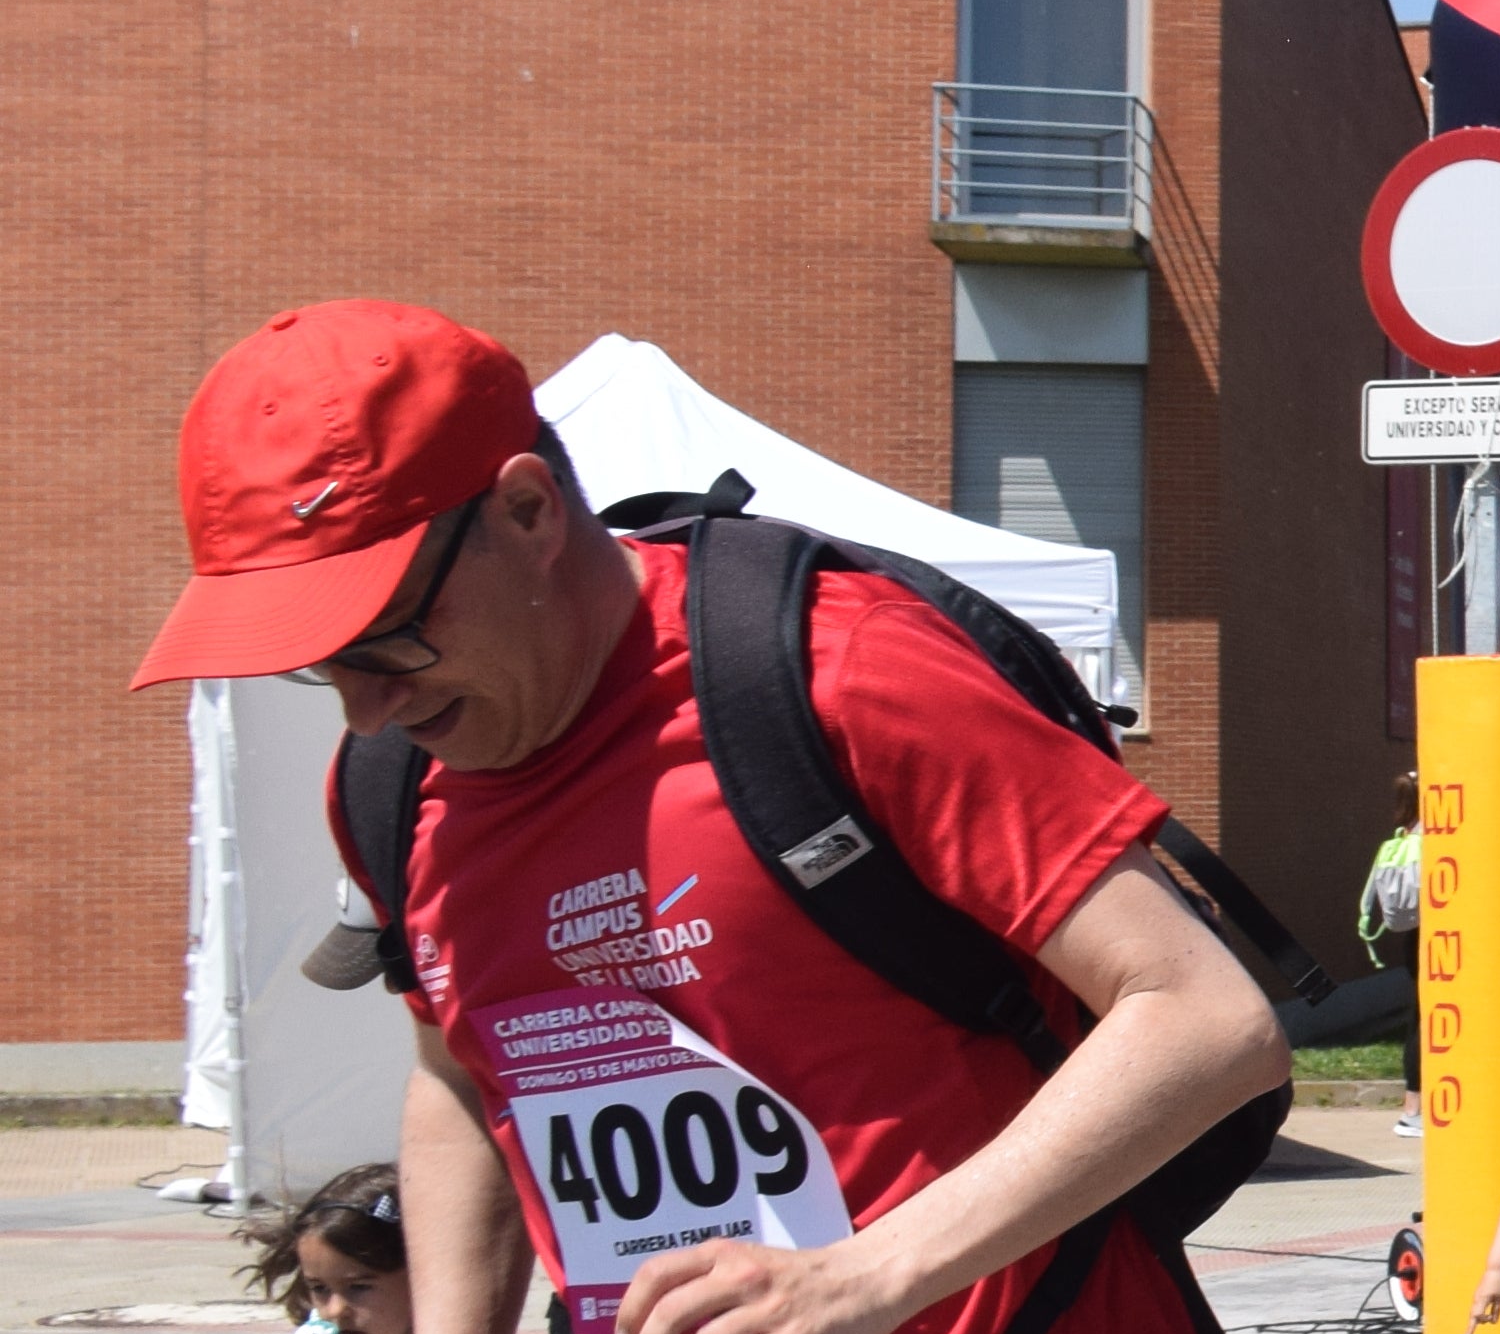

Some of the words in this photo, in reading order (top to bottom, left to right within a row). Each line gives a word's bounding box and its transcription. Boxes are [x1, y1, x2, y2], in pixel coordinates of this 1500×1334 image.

[1404, 398, 1466, 415] EXCEPTO
[1386, 420, 1474, 438] UNIVERSIDAD
[1480, 419, 1488, 436] Y
[548, 867, 647, 921] CARRERA
[546, 902, 643, 952] CAMPUS
[553, 917, 714, 972] UNIVERSIDAD
[635, 955, 703, 991] RIOJA
[1423, 783, 1464, 1129] MONDO
[494, 1001, 594, 1038] CARRERA
[502, 1020, 644, 1059] UNIVERSIDAD
[516, 1069, 577, 1090] DOMINGO
[580, 1067, 597, 1083] 15
[598, 1063, 622, 1079] DE
[623, 1055, 670, 1075] MAYO
[549, 1085, 809, 1224] 4009
[613, 1231, 679, 1257] CARRERA
[680, 1219, 754, 1247] FAMILIAR
